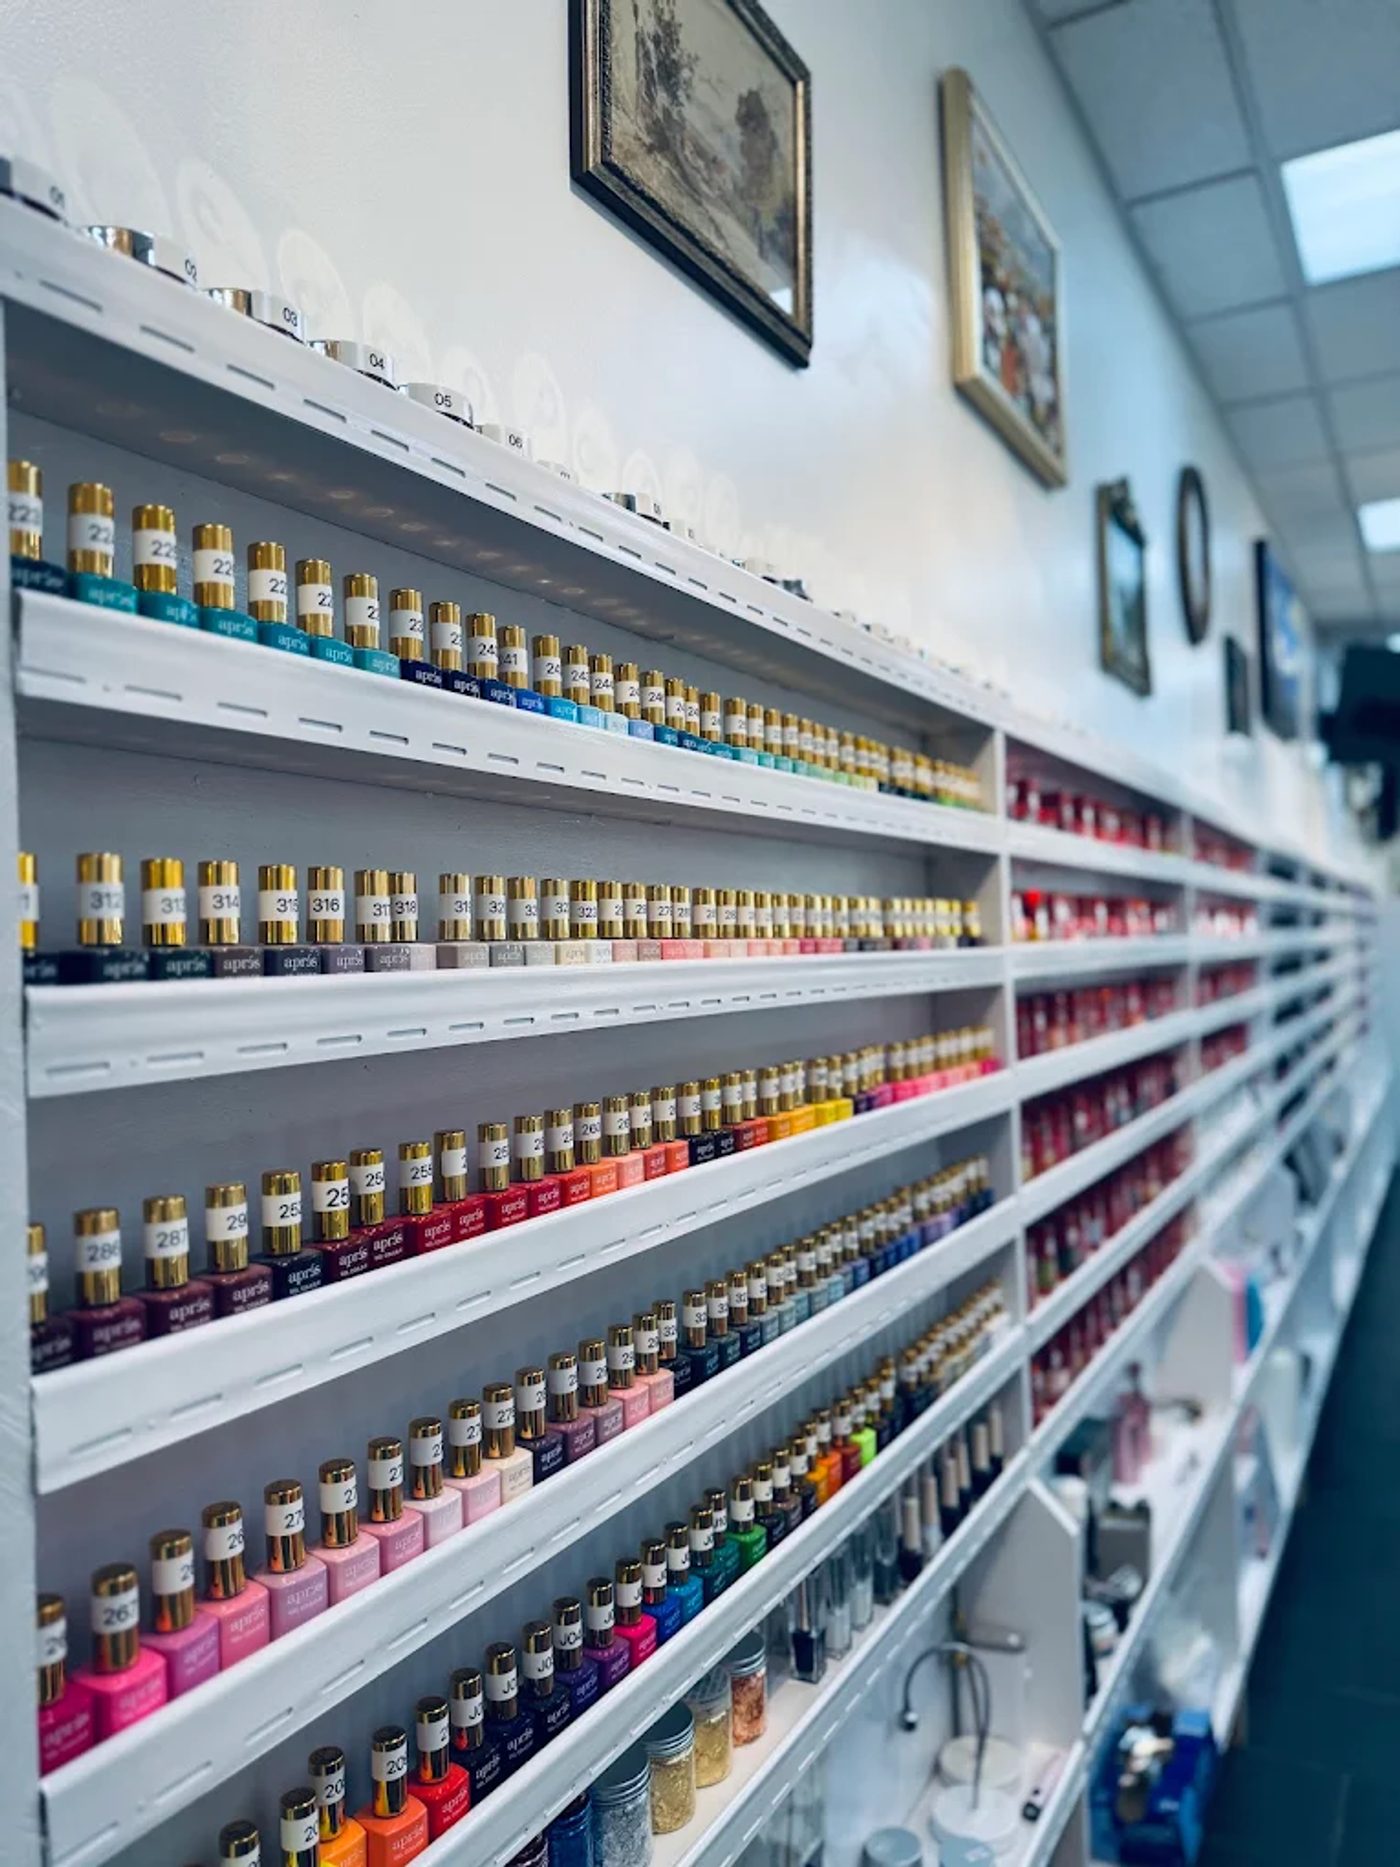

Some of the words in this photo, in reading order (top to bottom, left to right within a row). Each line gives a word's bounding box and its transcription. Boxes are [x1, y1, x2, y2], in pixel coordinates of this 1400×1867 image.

[184, 258, 198, 281] 02
[282, 307, 298, 327] 03
[369, 353, 384, 370] 04
[434, 392, 453, 408] 05
[508, 433, 523, 450] 06
[312, 898, 340, 913] 316
[394, 900, 417, 915] 318
